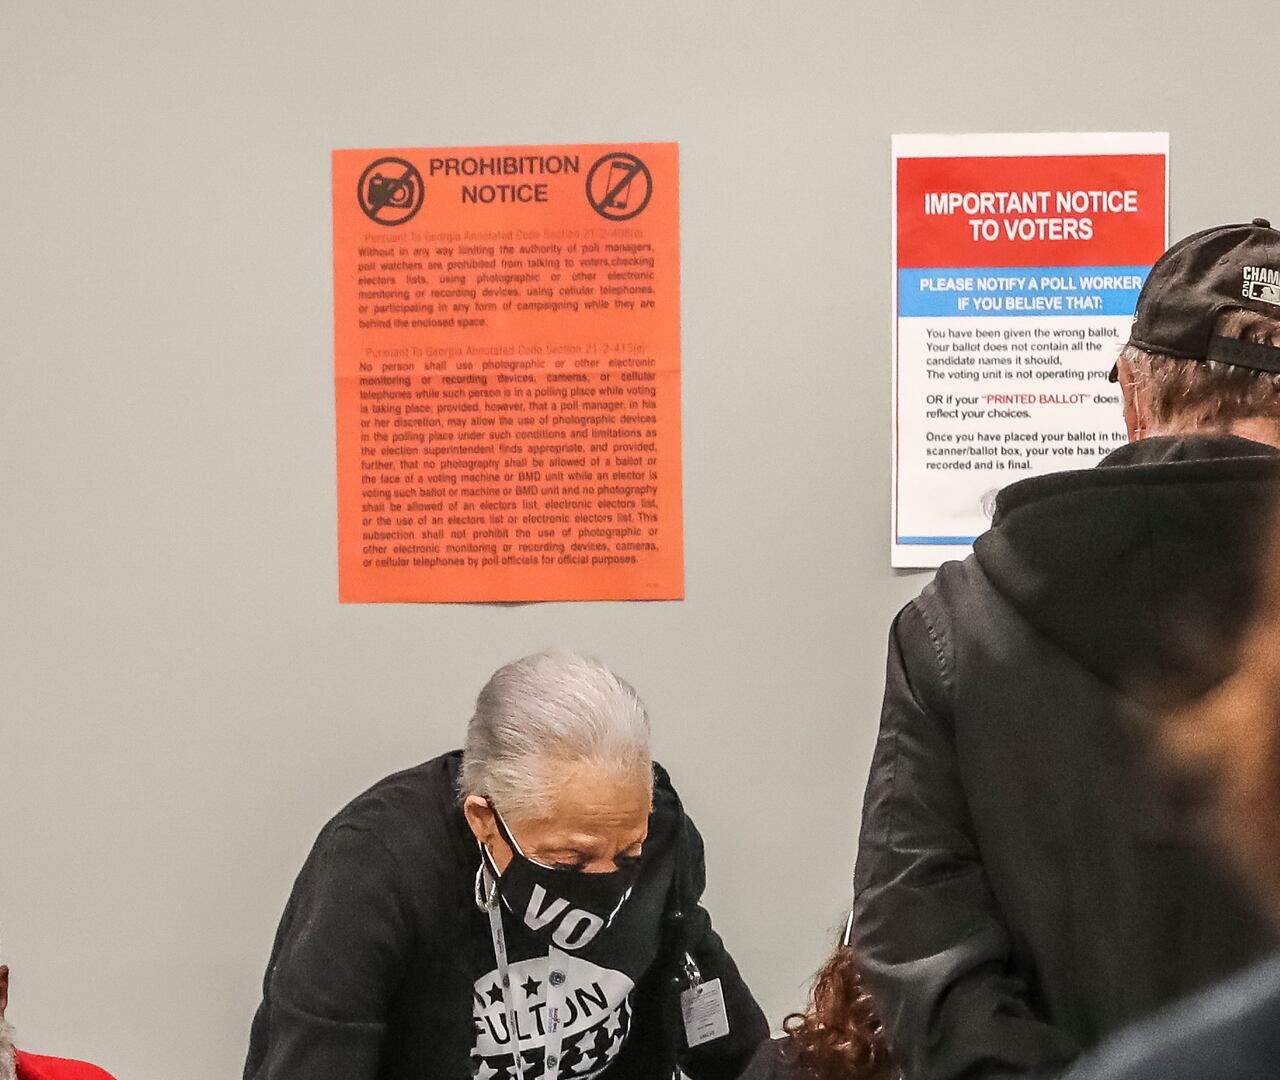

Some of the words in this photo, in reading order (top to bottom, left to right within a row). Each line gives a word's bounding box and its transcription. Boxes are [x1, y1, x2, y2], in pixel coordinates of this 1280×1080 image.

[429, 155, 580, 176] PROHIBITION
[462, 184, 549, 204] NOTICE
[925, 191, 1051, 215] IMPORTANT
[1057, 190, 1138, 213] NOTICE
[969, 219, 999, 242] TO
[1004, 217, 1093, 241] VOTERS
[920, 277, 973, 292] PLEASE
[977, 277, 1026, 292] NOTIFY
[1029, 277, 1040, 291] A
[1040, 277, 1077, 291] POLL
[1080, 276, 1142, 292] WORKER
[957, 297, 969, 311] IF
[972, 297, 1003, 311] YOU
[1004, 296, 1062, 310] BELIEVE
[926, 329, 945, 338] You
[948, 328, 972, 338] have
[976, 329, 1000, 338] been
[1004, 330, 1031, 340] given
[1034, 328, 1050, 337] the
[1053, 330, 1085, 340] wrong
[926, 342, 949, 352] Your
[952, 343, 980, 352] ballot
[983, 342, 1008, 351] does
[1011, 343, 1027, 351] not
[1031, 342, 1068, 351] contain
[1072, 341, 1083, 351] all
[1086, 341, 1102, 351] the
[926, 356, 975, 365] candidate
[1016, 356, 1022, 365] it
[926, 370, 945, 379] The
[948, 371, 979, 382] voting
[983, 370, 1001, 379] unit
[1017, 370, 1033, 379] not
[1036, 370, 1084, 381] operating
[1087, 371, 1110, 381] prop
[926, 395, 943, 404] OR
[946, 395, 952, 404] if
[955, 397, 979, 407] your
[1094, 394, 1120, 404] does
[926, 408, 958, 419] reflect
[962, 411, 985, 421] your
[988, 409, 1032, 418] choices.
[926, 432, 952, 442] Once
[955, 434, 974, 444] you
[977, 432, 1001, 442] have
[1004, 432, 1038, 444] placed
[1041, 434, 1064, 444] your
[1068, 432, 1096, 442] ballot
[1099, 433, 1108, 441] in
[1112, 432, 1128, 441] the
[926, 447, 997, 456] scanner/ballot
[1026, 448, 1049, 458] your
[1053, 447, 1074, 456] vote
[1078, 446, 1095, 456] has
[1098, 446, 1115, 456] be
[926, 460, 971, 470] recorded
[975, 460, 993, 470] and
[996, 461, 1005, 470] is
[375, 557, 409, 567] cellular
[413, 556, 464, 567] telephones
[468, 557, 478, 568] by
[482, 555, 499, 567] poll
[502, 556, 539, 565] officials
[542, 554, 554, 564] for
[558, 554, 589, 564] official
[593, 556, 639, 566] purposes.
